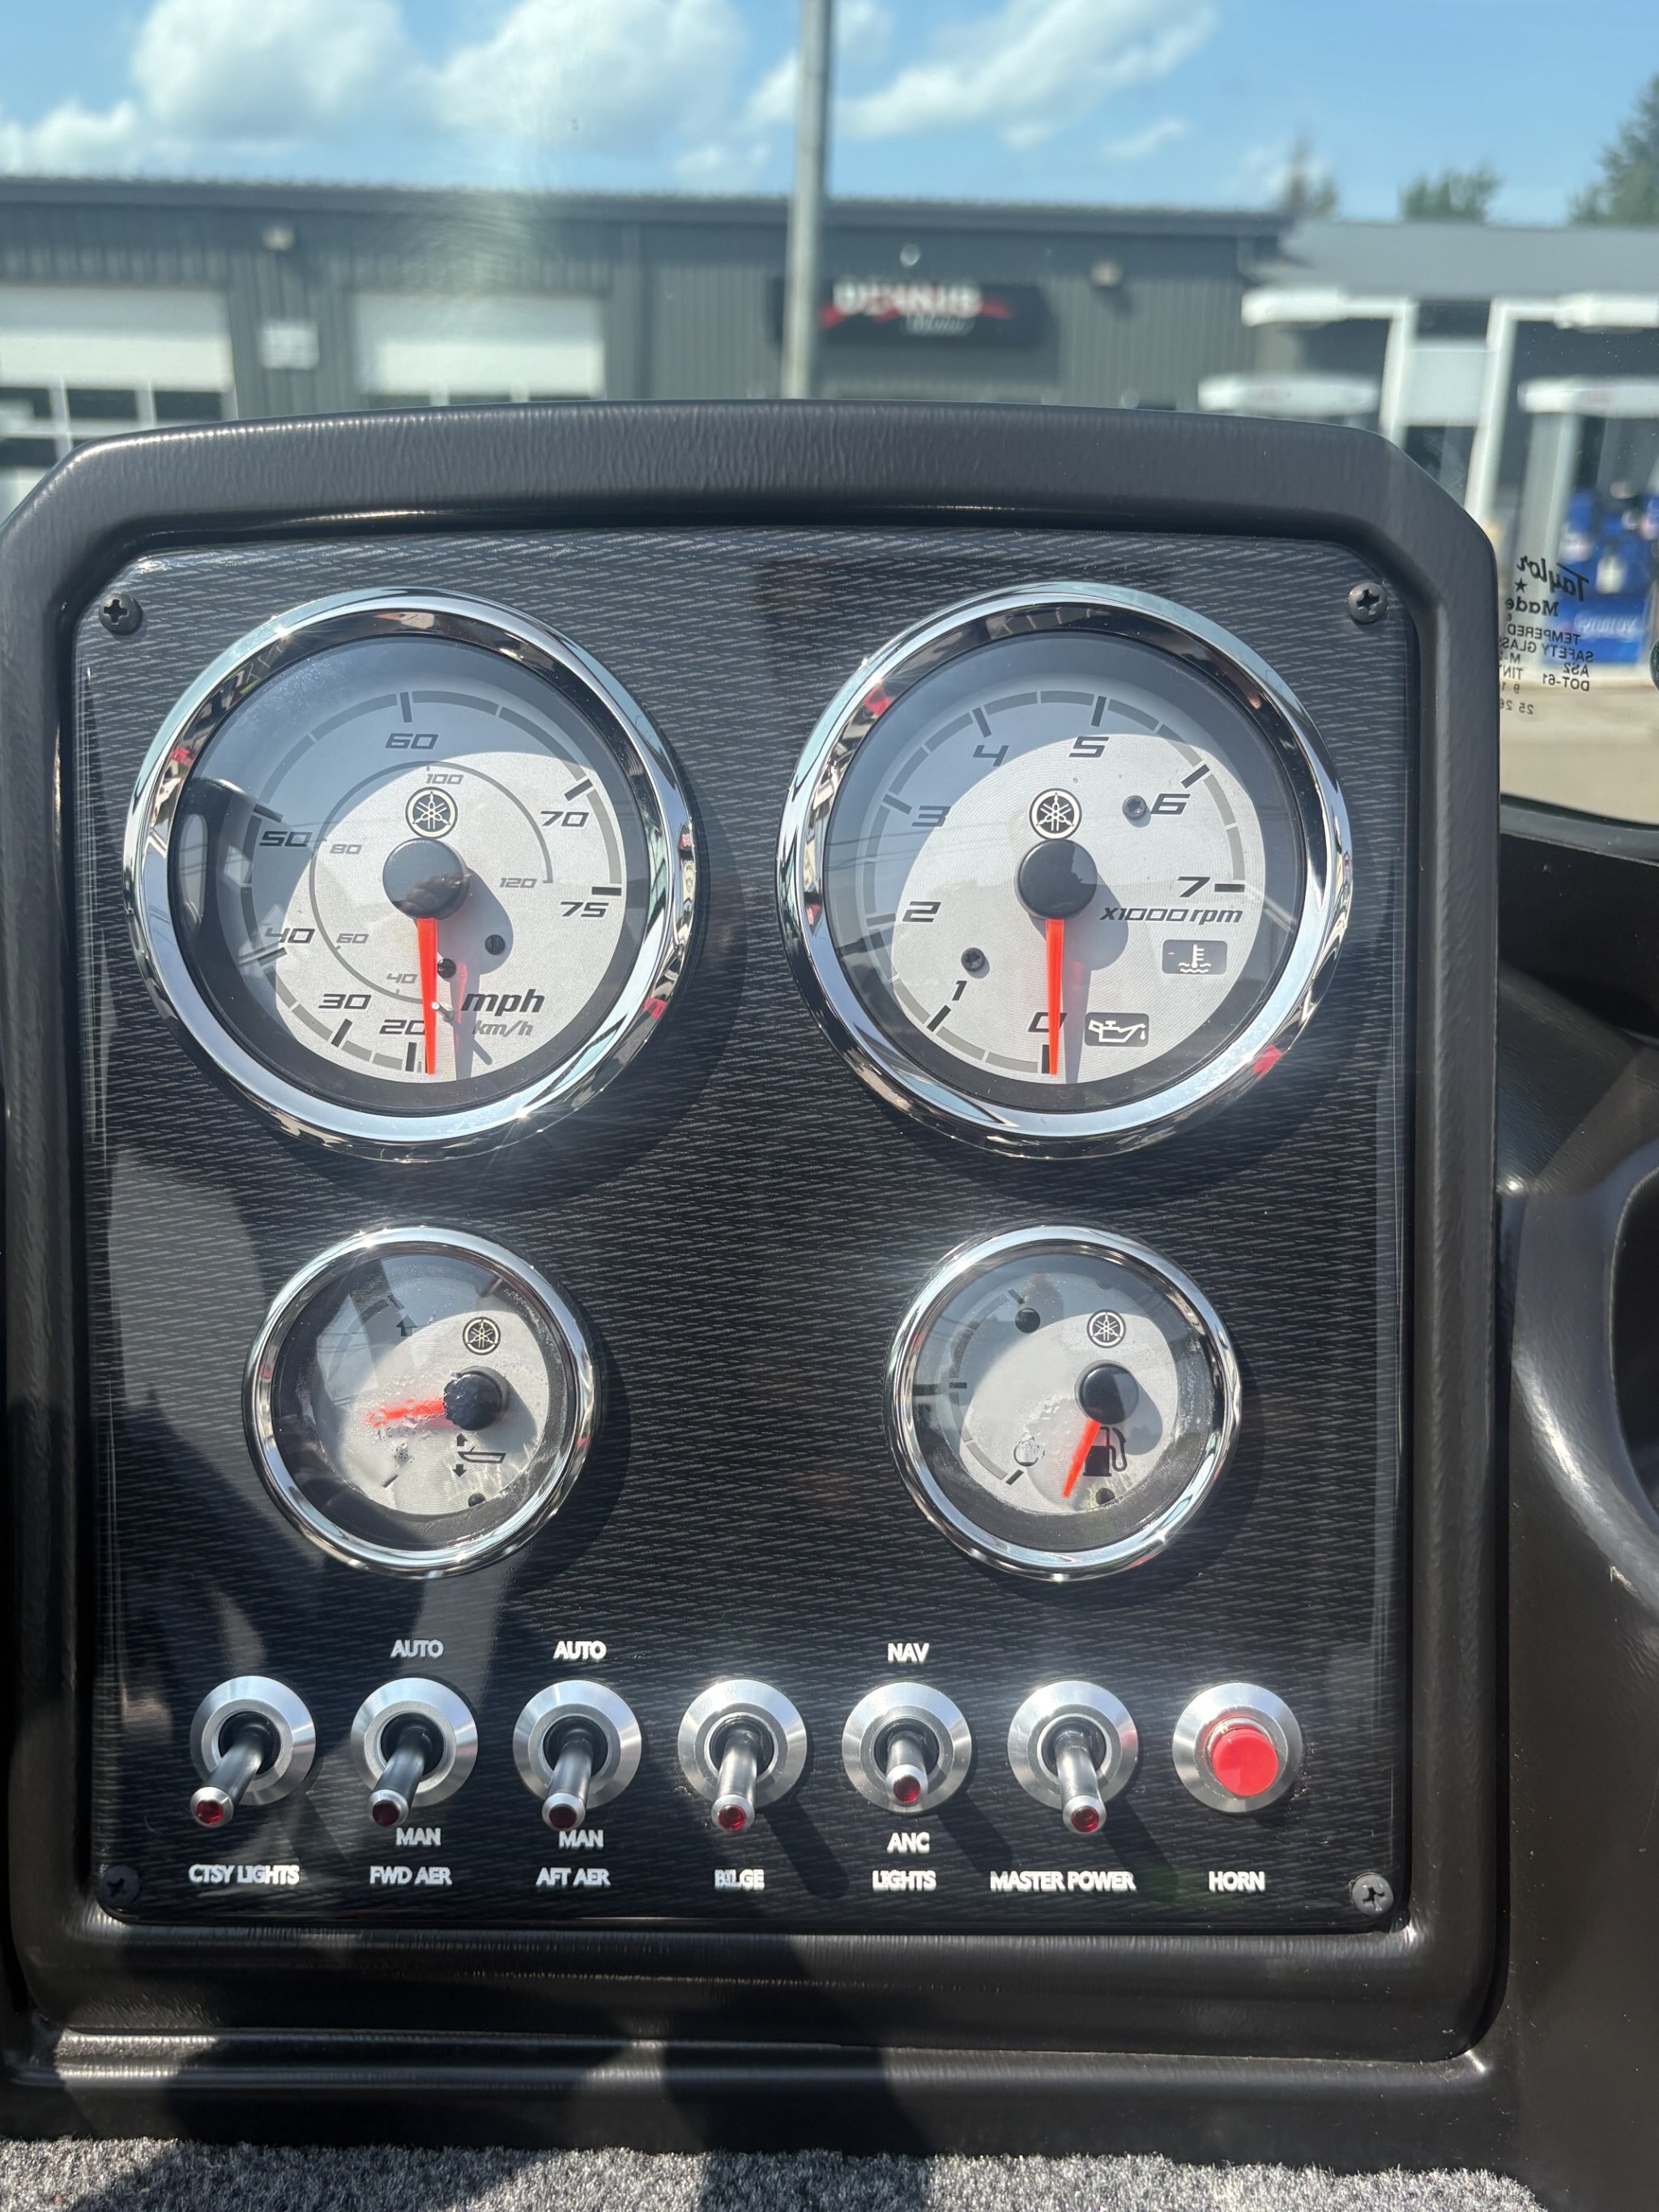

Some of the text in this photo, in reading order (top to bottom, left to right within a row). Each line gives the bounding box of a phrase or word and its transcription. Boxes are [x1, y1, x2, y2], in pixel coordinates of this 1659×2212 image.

[385, 732, 438, 750] 60
[1068, 736, 1110, 758] 5
[973, 744, 1010, 767] 4
[425, 773, 463, 785] 100
[1149, 794, 1191, 815] 6
[539, 810, 590, 828] 70
[912, 806, 951, 827] 3
[258, 830, 312, 848] 50
[330, 842, 362, 855] 80
[499, 877, 537, 889] 120
[1176, 876, 1210, 897] 7
[560, 901, 608, 918] 75
[902, 901, 941, 923] 2
[264, 927, 314, 945] 40
[335, 932, 369, 944] 60
[386, 972, 418, 984] 40
[951, 980, 967, 1001] 1
[318, 993, 371, 1011] 30
[461, 988, 544, 1014] mph
[378, 1019, 426, 1035] 20
[471, 1019, 533, 1036] km/h
[390, 1639, 445, 1659] AUTO
[553, 1641, 607, 1661] AUTO
[887, 1643, 930, 1664] NAV
[395, 1828, 441, 1848] MAN
[559, 1830, 604, 1851] MAN
[887, 1832, 930, 1854] ANC
[188, 1864, 301, 1886] CTSY LIGHTS
[369, 1867, 452, 1886] FWD AER
[535, 1868, 611, 1887] AFT AER
[714, 1869, 766, 1890] BILGE
[872, 1870, 936, 1892] LIGHTS
[990, 1871, 1137, 1893] MASTER POWER
[1208, 1871, 1265, 1893] HORN
